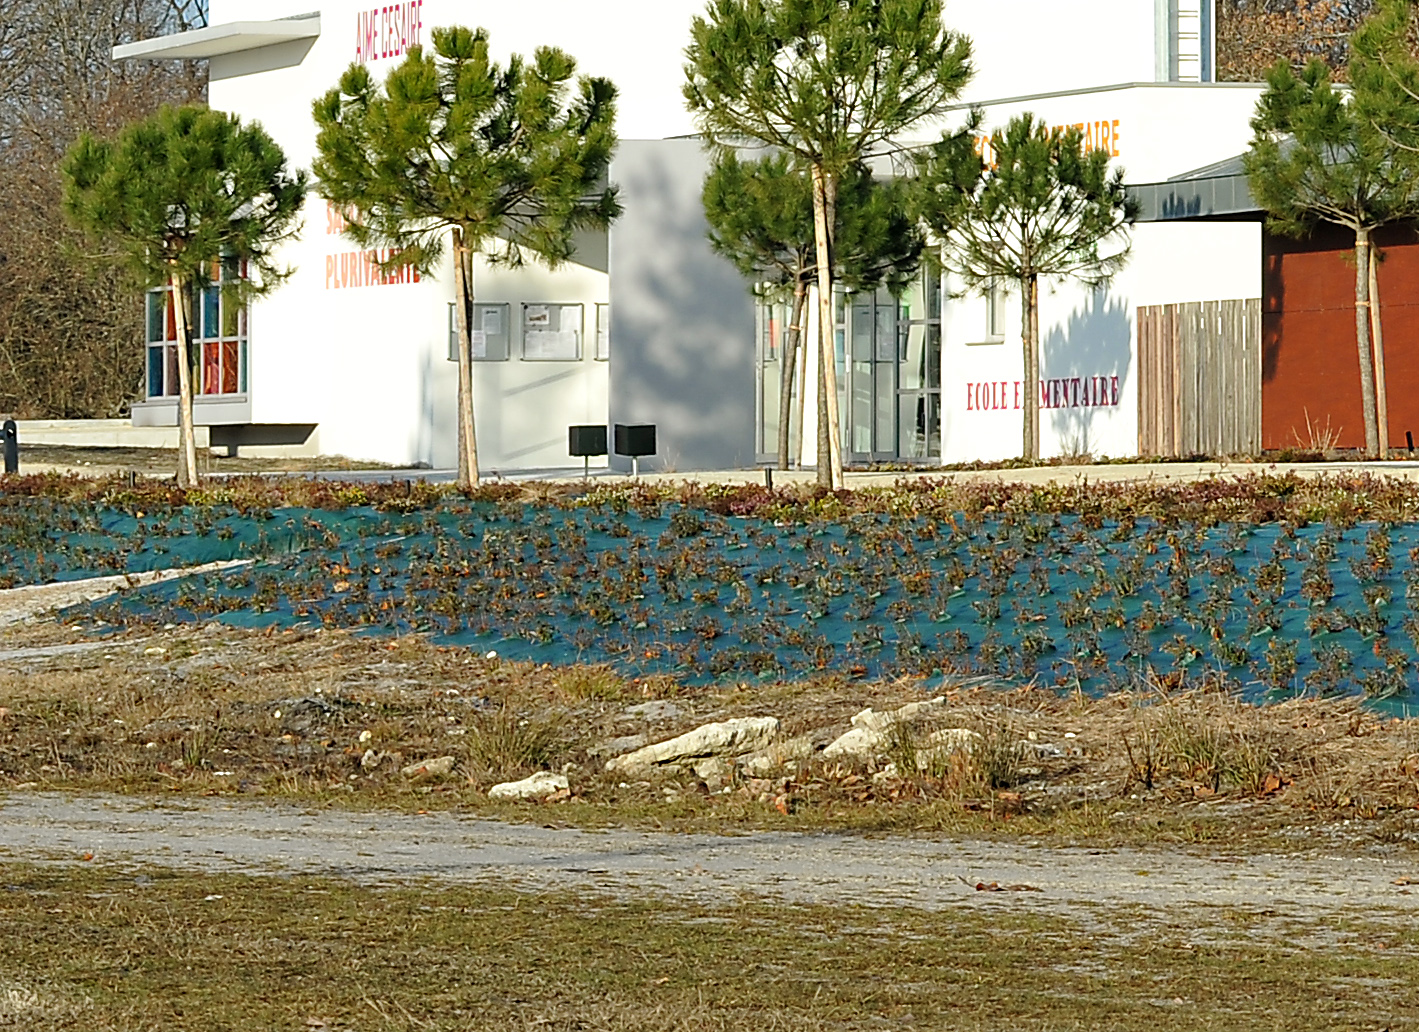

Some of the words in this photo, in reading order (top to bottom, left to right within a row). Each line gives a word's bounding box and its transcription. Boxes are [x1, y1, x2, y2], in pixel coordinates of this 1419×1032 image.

[356, 9, 379, 64] AIME
[382, 0, 423, 58] CESAIRE
[966, 381, 1008, 411] ECOLE
[1013, 375, 1119, 410] EMENTAIRE
